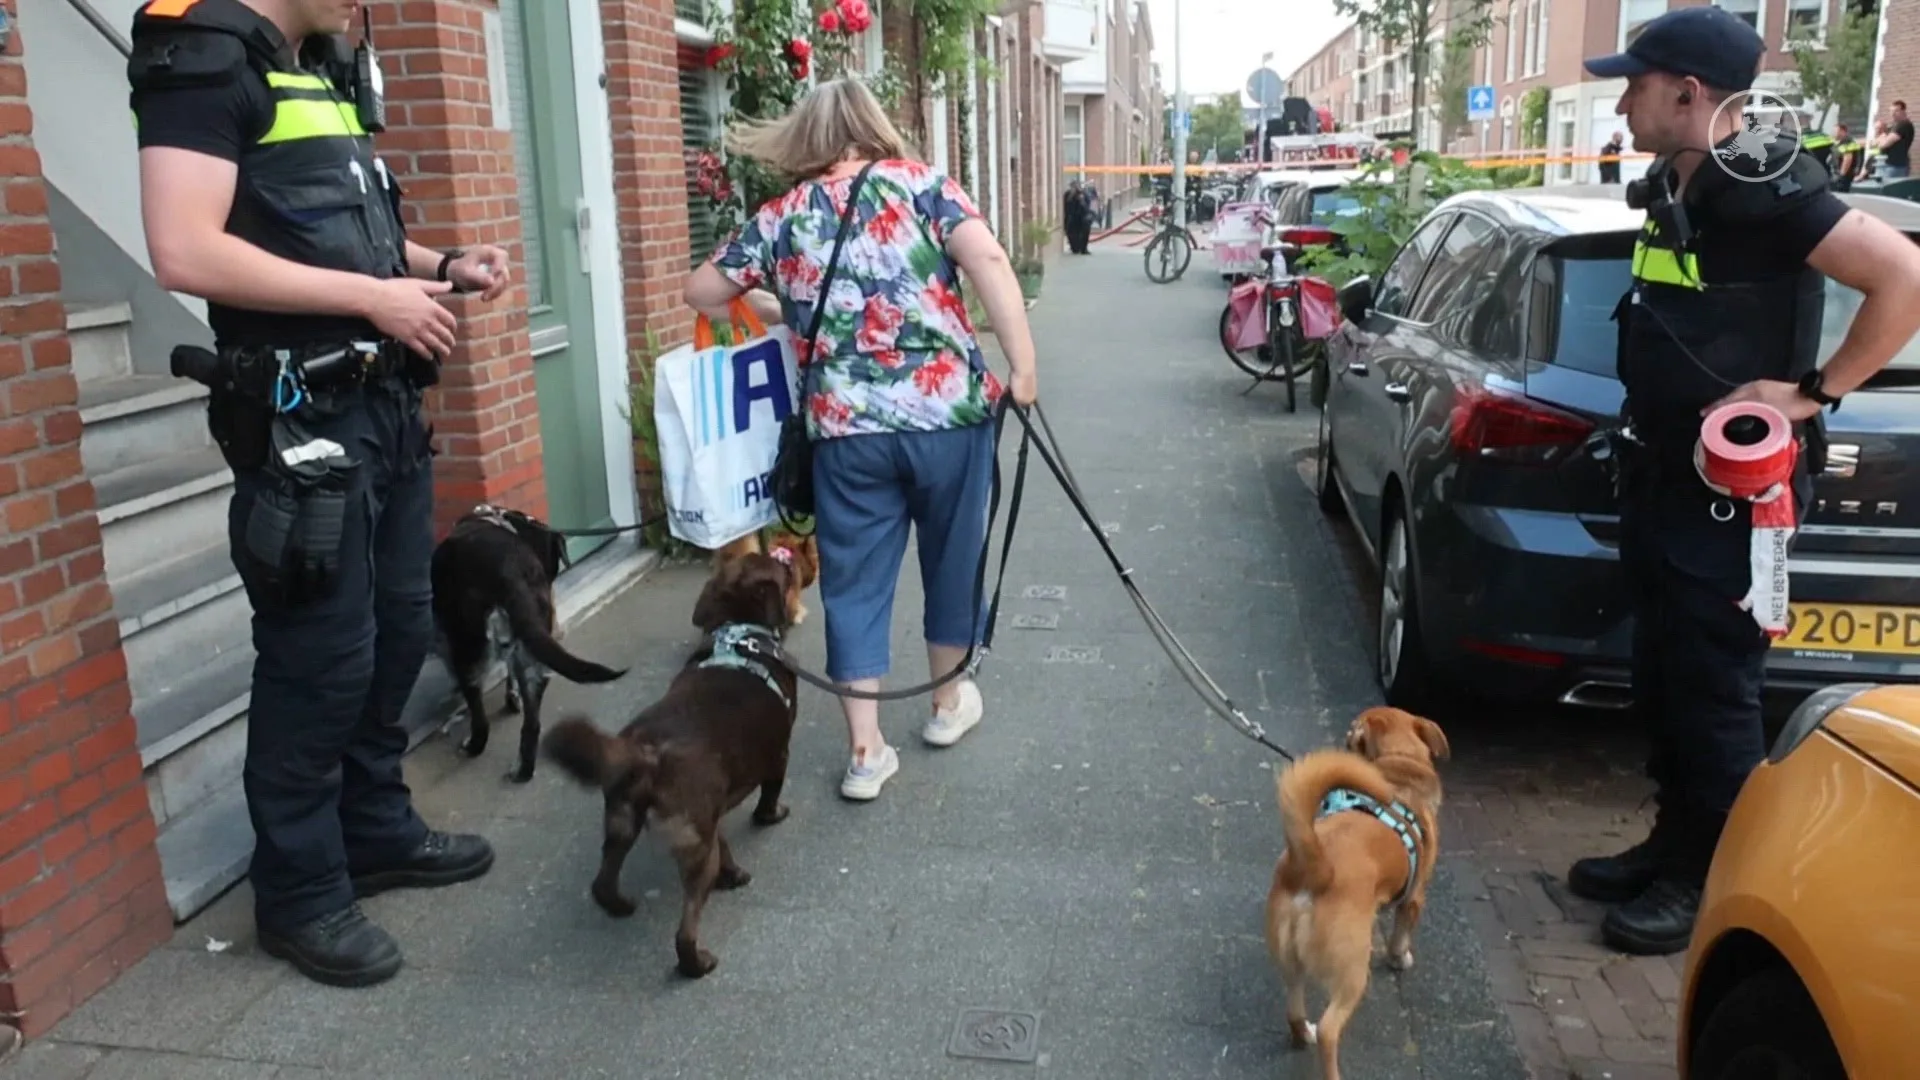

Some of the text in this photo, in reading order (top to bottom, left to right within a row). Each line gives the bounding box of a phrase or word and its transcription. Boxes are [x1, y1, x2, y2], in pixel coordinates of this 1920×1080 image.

[731, 338, 793, 434] A
[1771, 529, 1785, 622] NIET BETREDEN
